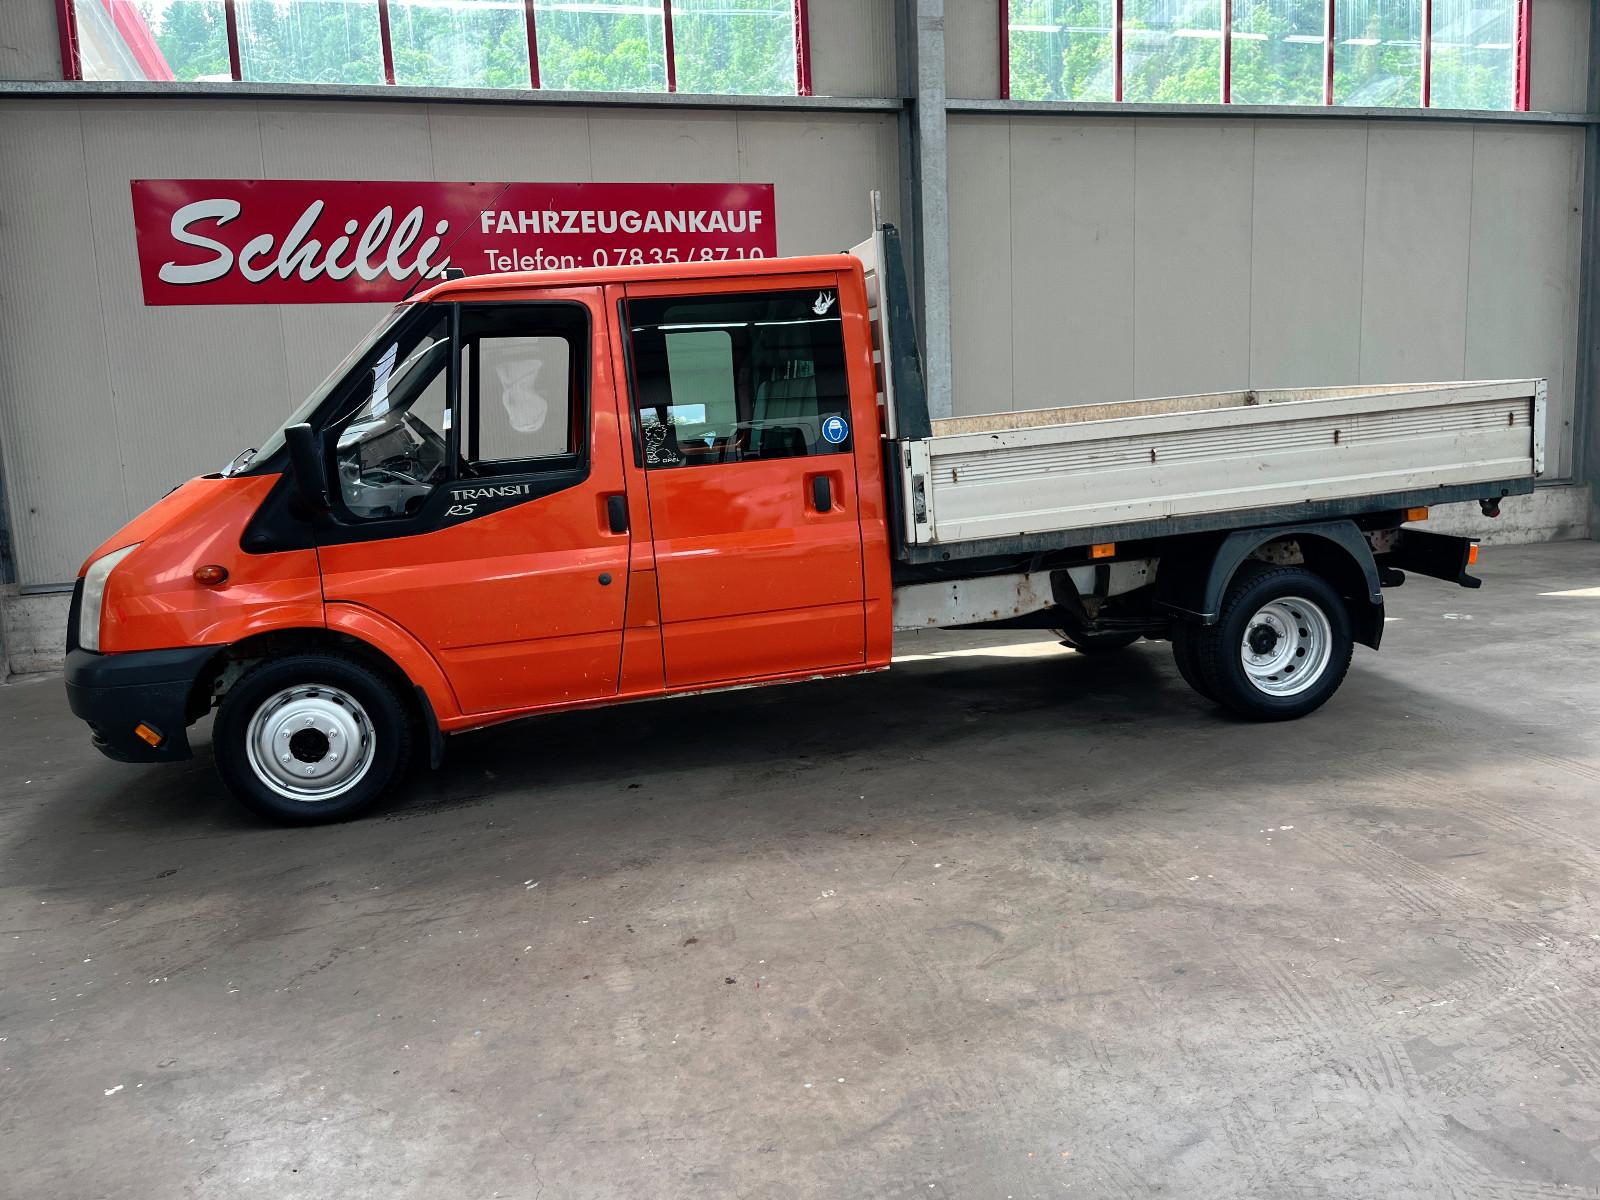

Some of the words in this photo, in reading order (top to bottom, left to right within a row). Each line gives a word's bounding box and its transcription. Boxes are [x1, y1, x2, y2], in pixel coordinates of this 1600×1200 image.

[480, 210, 762, 234] FAHRZEUGANKAUF
[158, 198, 450, 284] Schilli
[484, 248, 583, 271] Telefon:
[450, 484, 532, 501] TRANSIT
[444, 503, 478, 517] RS
